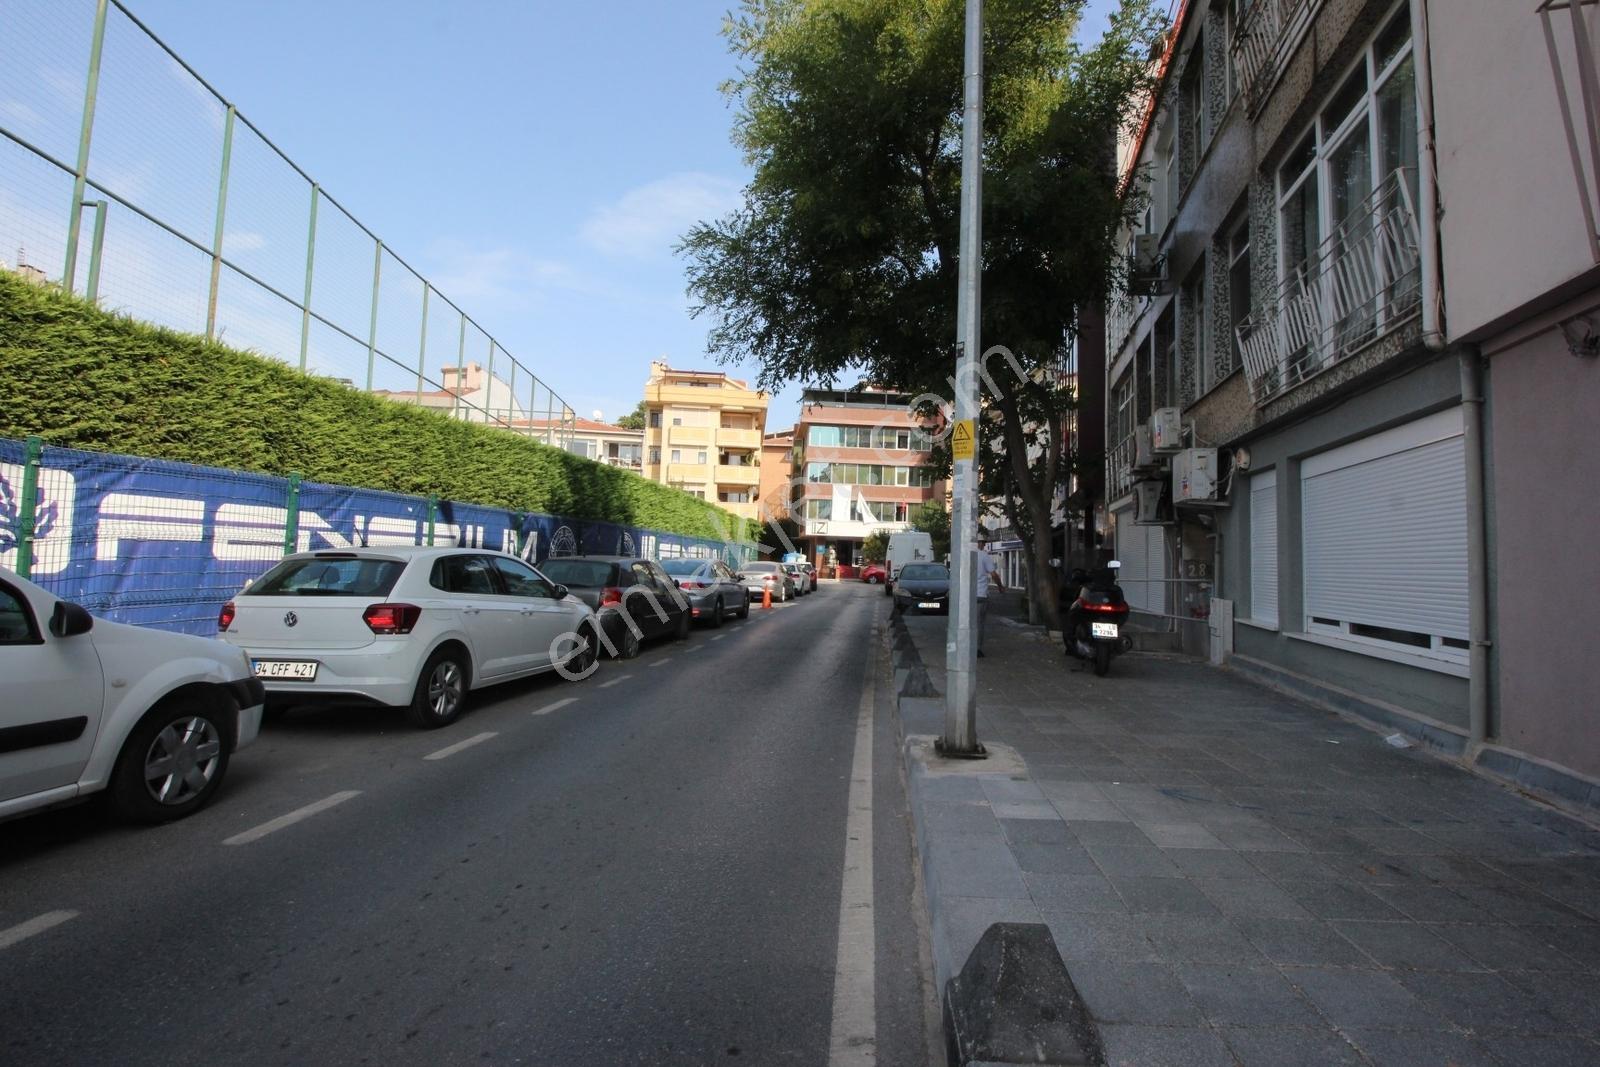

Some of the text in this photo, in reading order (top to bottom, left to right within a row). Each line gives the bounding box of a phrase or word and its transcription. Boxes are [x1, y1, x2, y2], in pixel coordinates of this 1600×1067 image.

[1188, 563, 1207, 577] 28
[255, 663, 313, 676] 34 CFF 421
